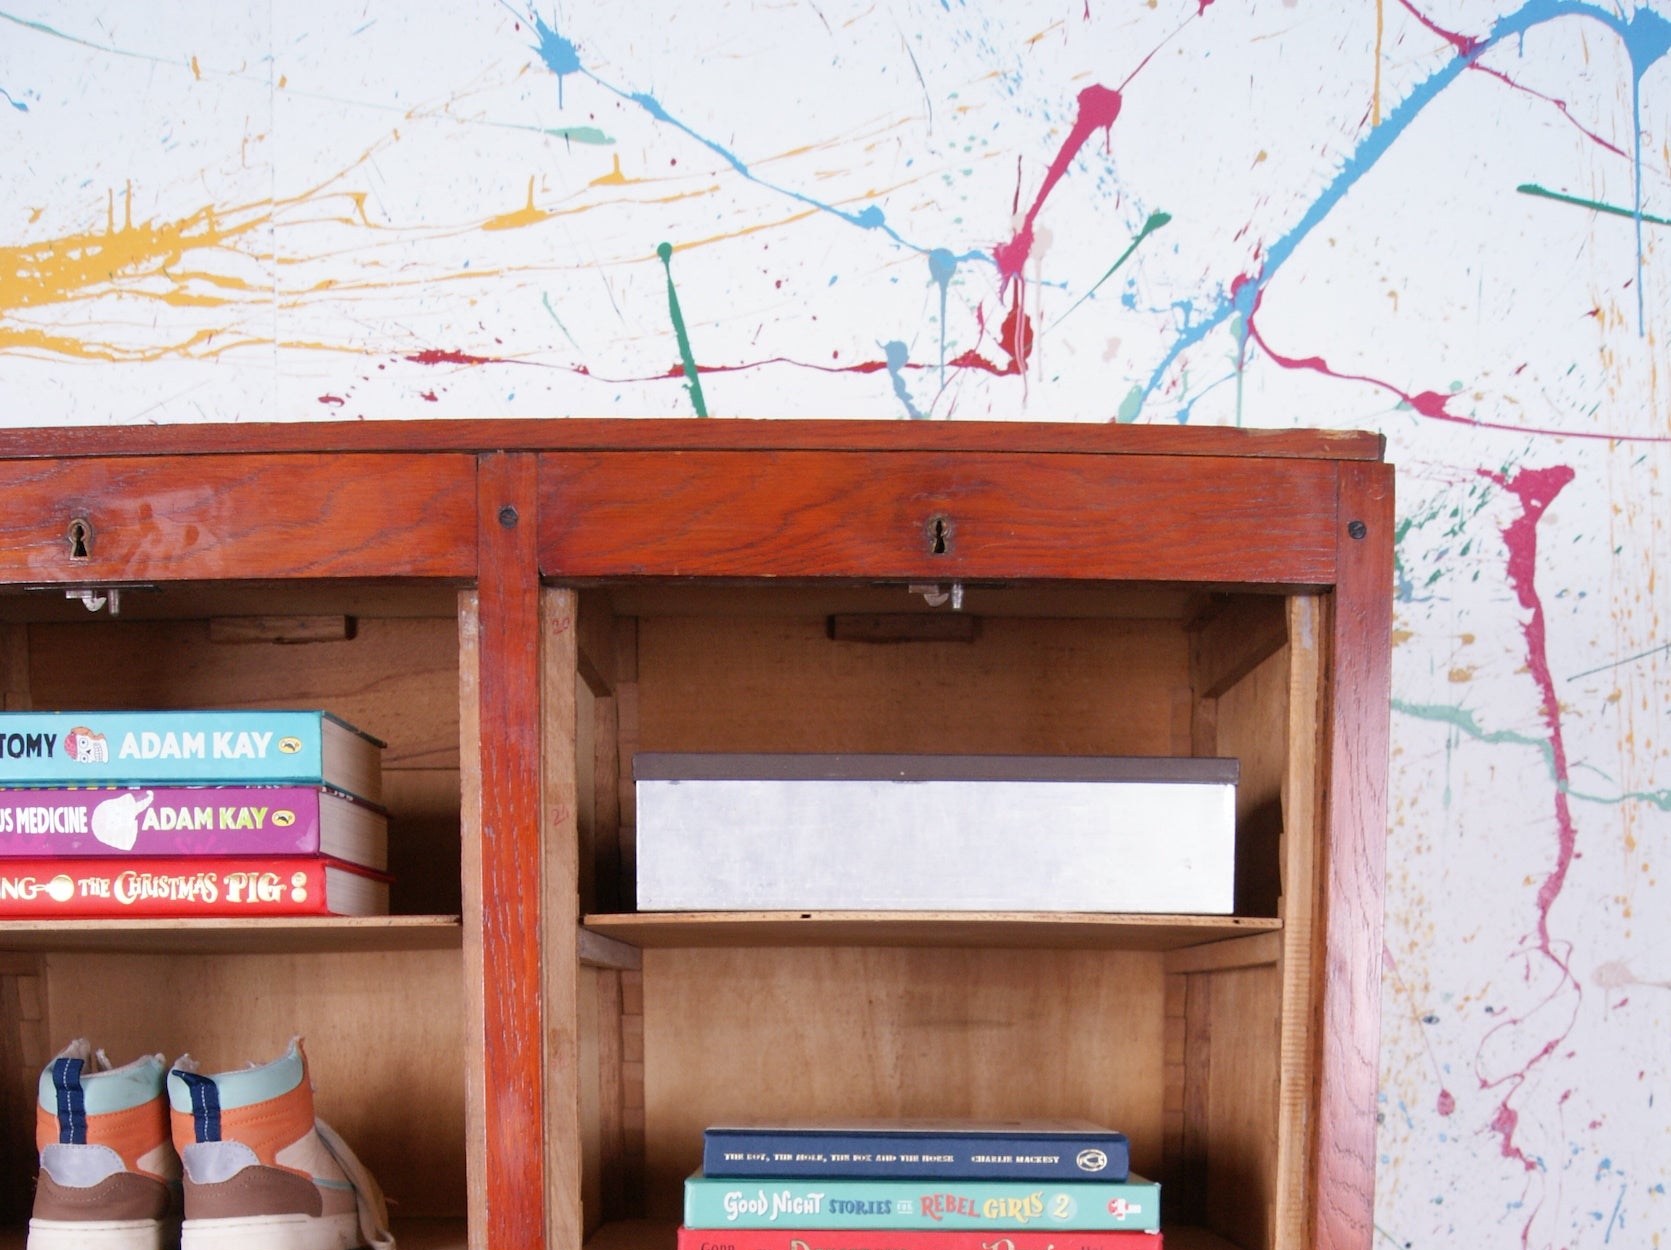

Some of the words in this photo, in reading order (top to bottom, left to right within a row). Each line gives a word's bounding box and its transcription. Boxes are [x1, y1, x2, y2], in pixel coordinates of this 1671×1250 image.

[118, 732, 206, 759] ADAM
[213, 732, 273, 758] KAY
[16, 806, 88, 834] MEDICINE
[142, 807, 213, 831] ADAM
[219, 807, 268, 829] KAY
[78, 880, 110, 898] THE
[113, 871, 218, 904] CHRISTMAS
[224, 872, 287, 903] PIG
[921, 1154, 954, 1163] HORSE
[971, 1155, 1013, 1164] CHARLIE
[1015, 1155, 1060, 1164] MACKESY
[828, 1199, 892, 1215] STORIES
[920, 1193, 980, 1221] REBEL
[1053, 1194, 1069, 1218] 2
